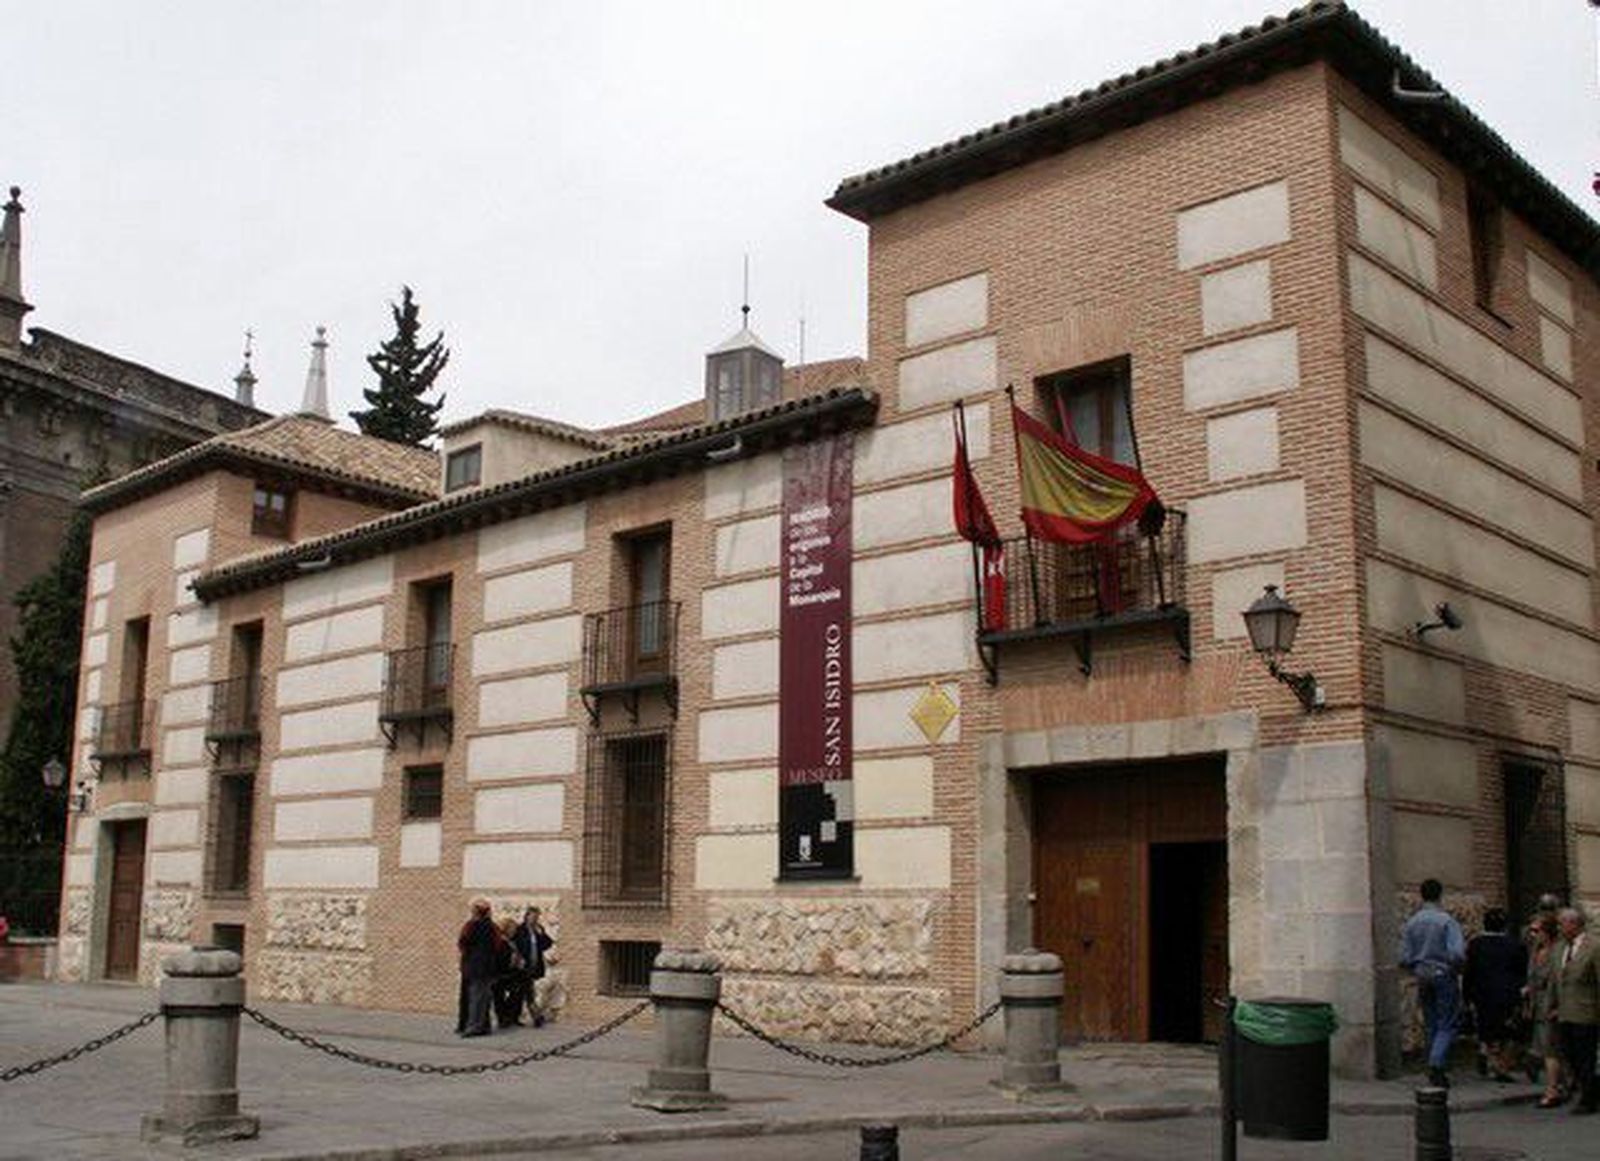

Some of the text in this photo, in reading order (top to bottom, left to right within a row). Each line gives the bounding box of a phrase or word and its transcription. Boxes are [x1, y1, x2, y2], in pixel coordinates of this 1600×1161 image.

[825, 623, 841, 766] SAN ISIDRO
[788, 766, 843, 784] MUSEO
